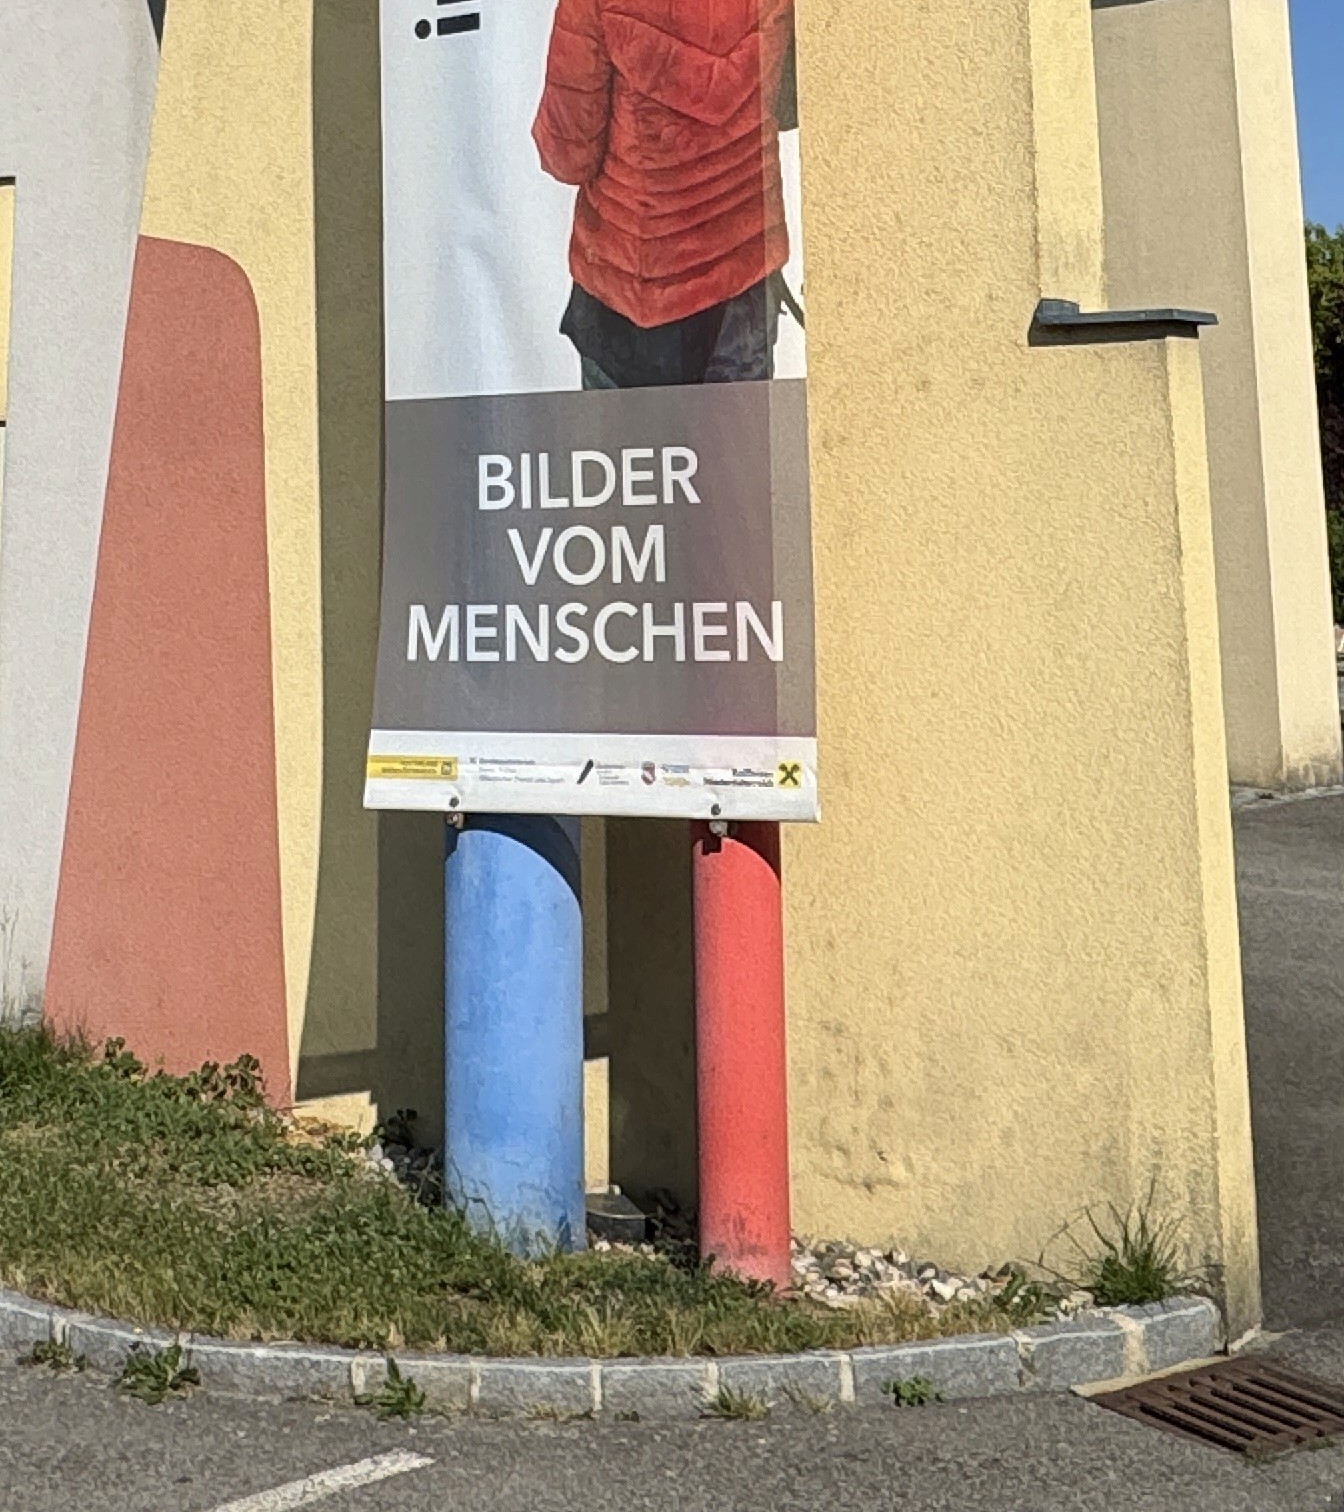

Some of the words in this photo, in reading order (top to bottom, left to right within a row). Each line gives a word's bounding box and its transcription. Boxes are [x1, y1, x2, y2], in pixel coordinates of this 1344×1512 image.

[477, 446, 701, 511] BILDER
[506, 524, 667, 586] VOM
[406, 600, 785, 664] MENSCHEN
